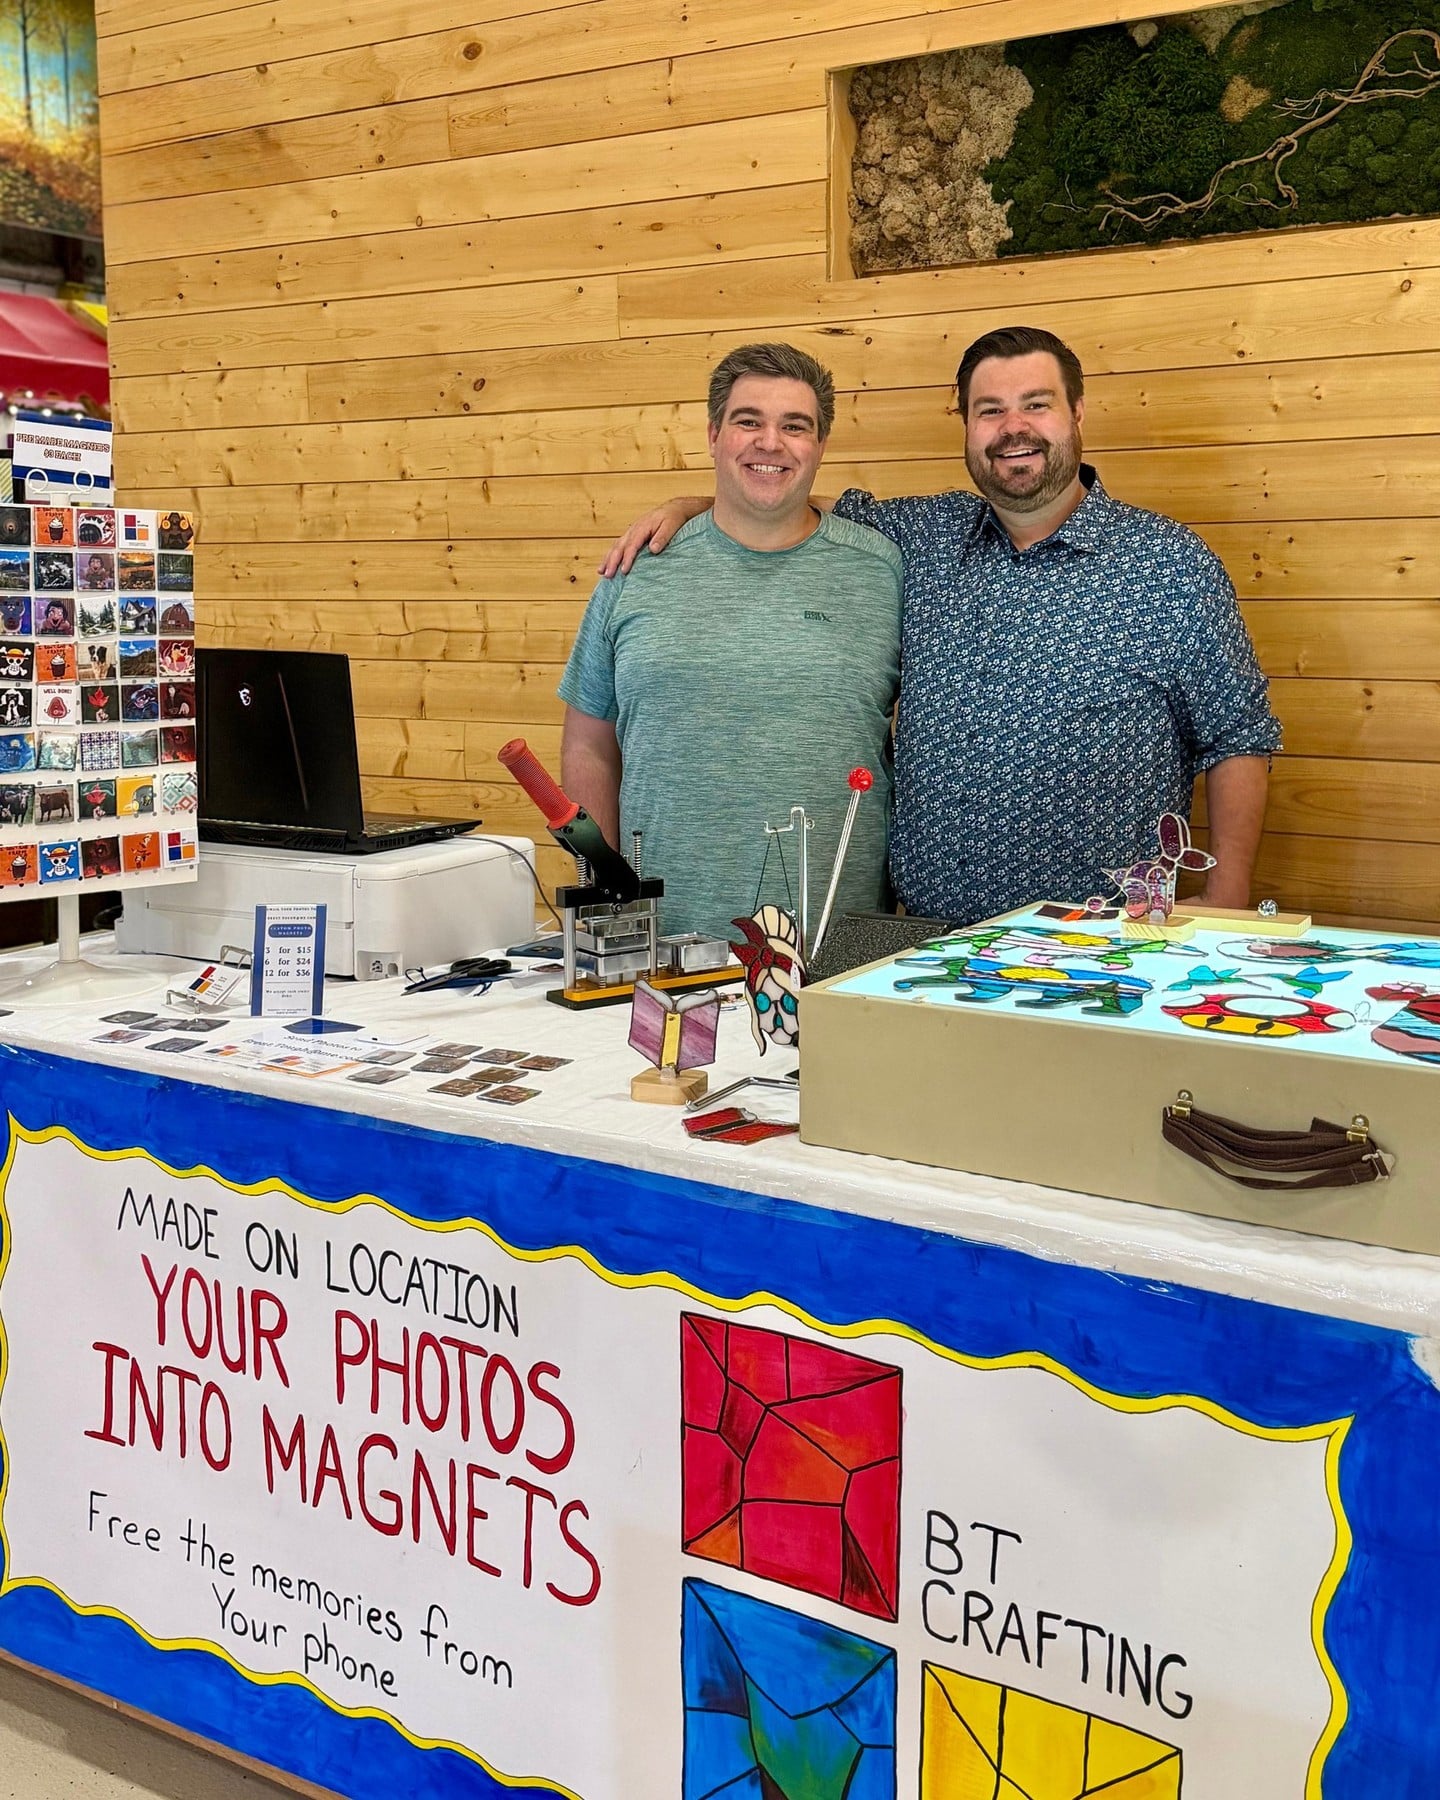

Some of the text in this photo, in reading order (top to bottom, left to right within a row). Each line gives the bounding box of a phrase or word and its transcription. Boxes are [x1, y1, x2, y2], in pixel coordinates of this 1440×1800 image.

[16, 432, 110, 453] PRE MADE MAGNETS
[55, 450, 81, 461] EACH
[265, 946, 311, 954] 3 for $15
[265, 969, 311, 977] 12 for $36
[117, 1187, 519, 1337] MADE ON LOCATION
[140, 1253, 576, 1475] YOUR PHOTOS
[84, 1341, 602, 1606] INTO MAGNETS
[88, 1490, 513, 1689] Free the memories from
[925, 1510, 1022, 1585] BT
[211, 1583, 399, 1698] Your phone
[921, 1579, 1193, 1720] CRAFTING
